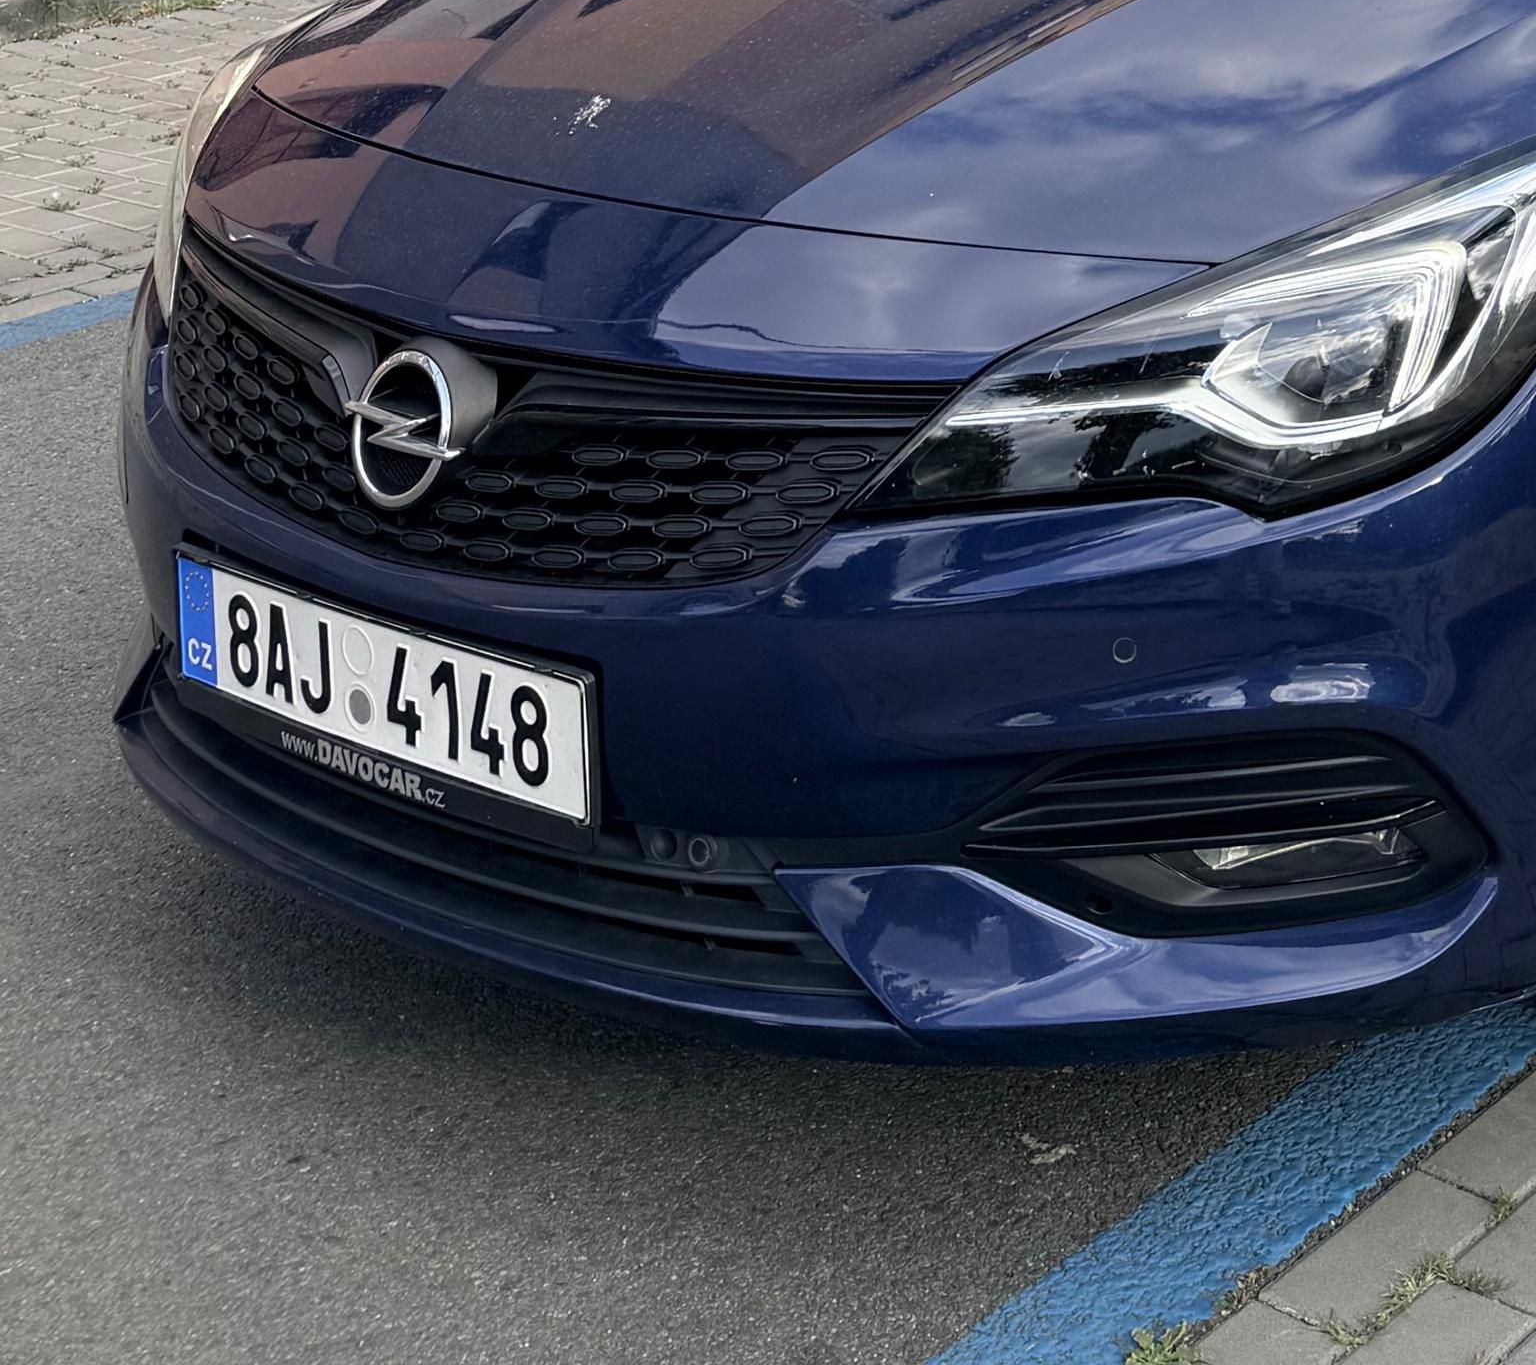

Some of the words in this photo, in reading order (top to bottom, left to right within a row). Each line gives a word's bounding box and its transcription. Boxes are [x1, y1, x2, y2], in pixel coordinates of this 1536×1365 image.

[187, 637, 213, 671] CZ
[227, 592, 332, 715] 8AJ
[386, 645, 549, 787] 4148
